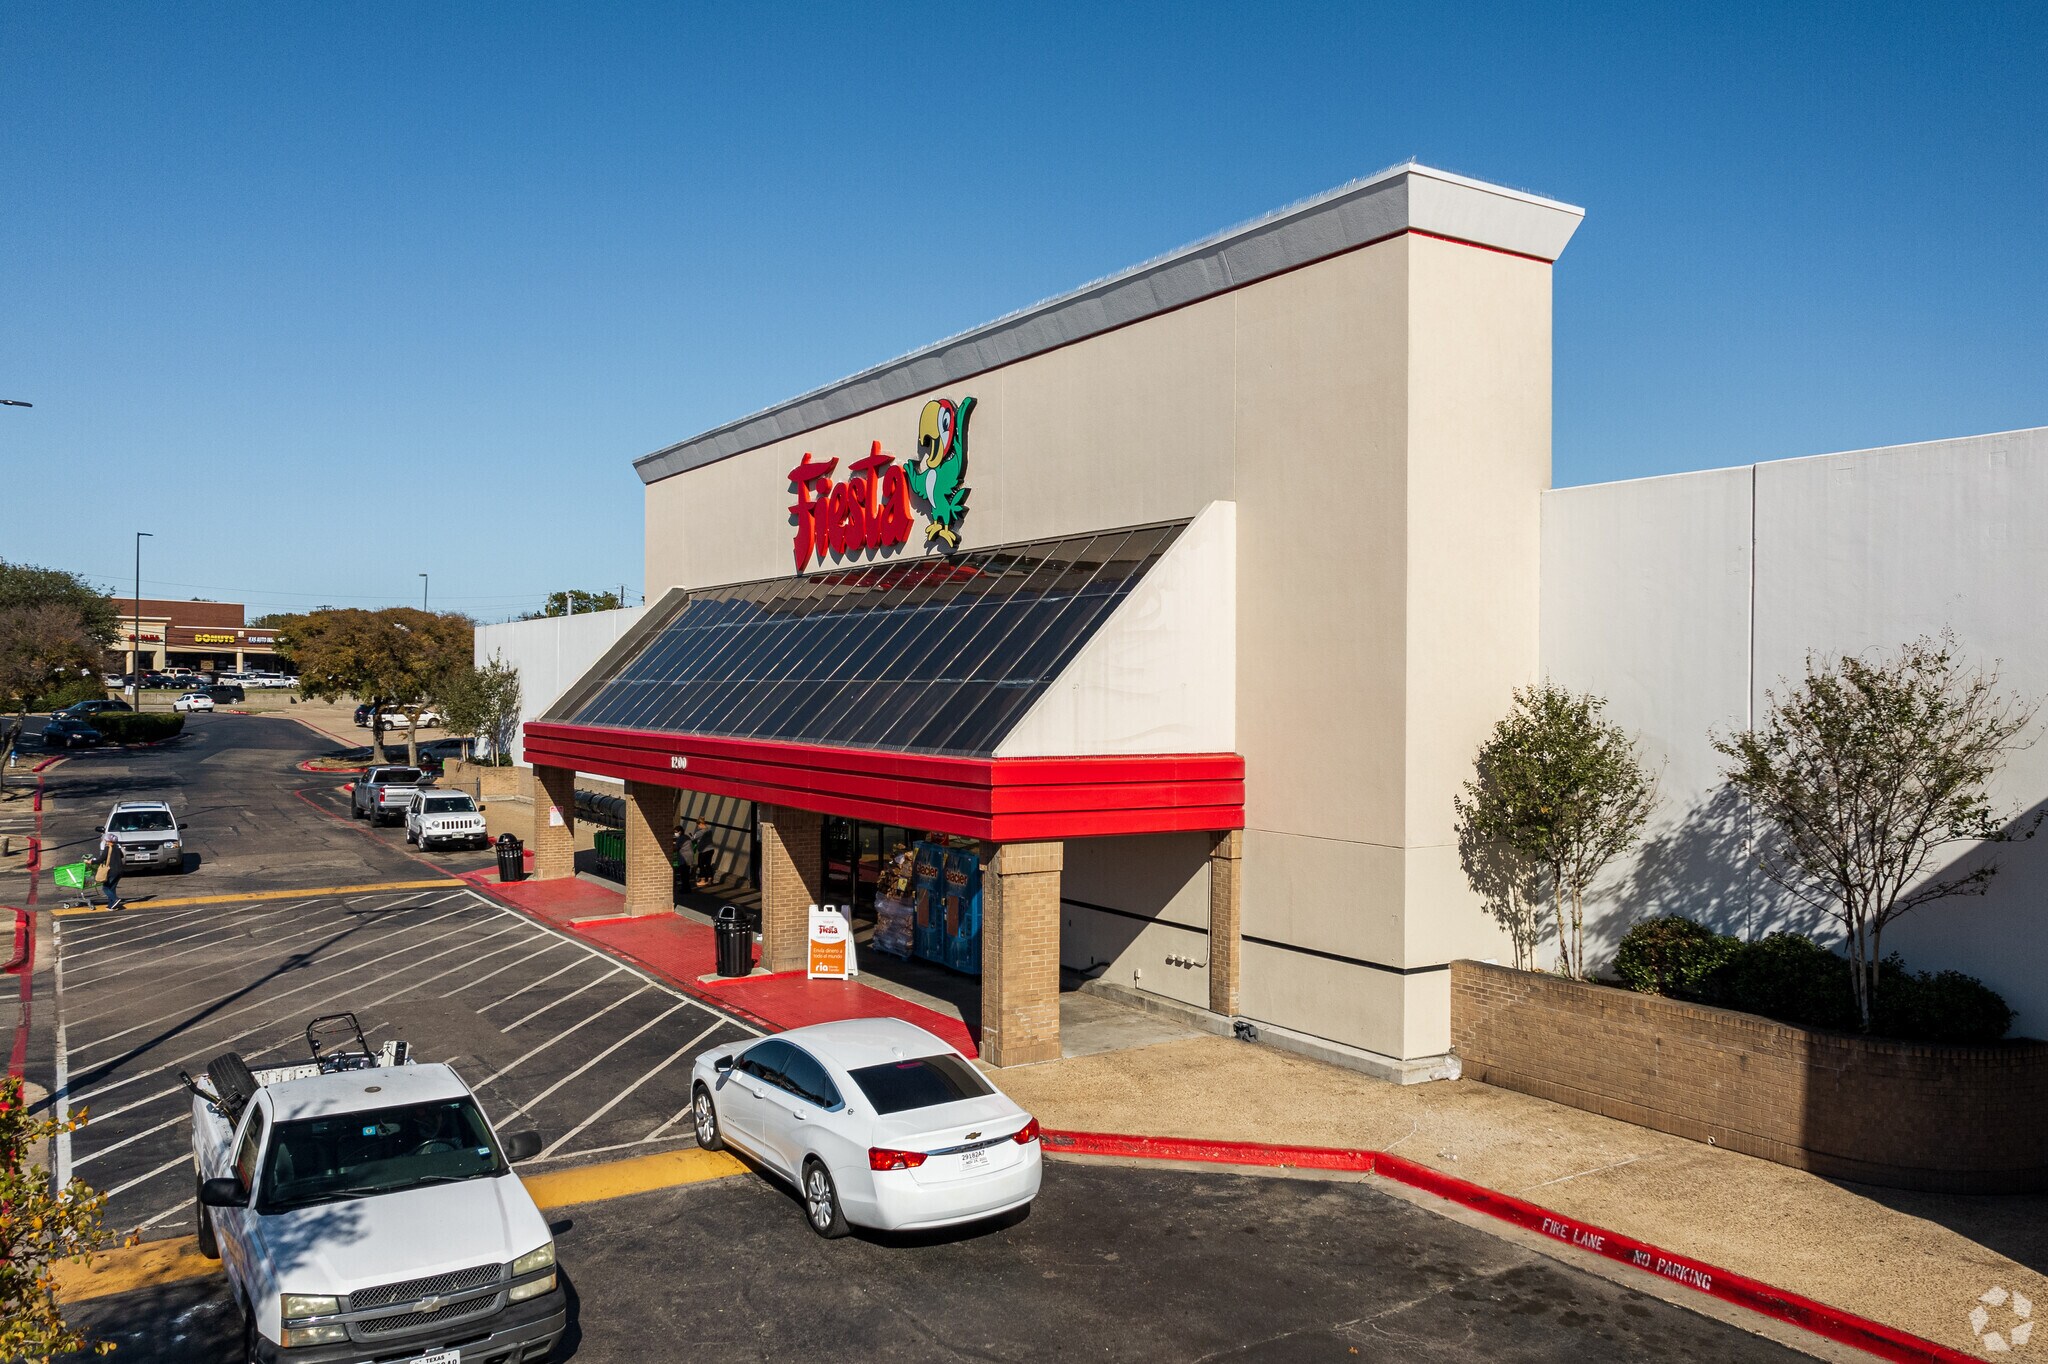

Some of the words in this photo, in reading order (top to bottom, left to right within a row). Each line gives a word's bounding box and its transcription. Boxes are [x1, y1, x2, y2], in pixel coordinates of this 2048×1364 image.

[788, 440, 914, 573] Fiesta
[194, 633, 235, 643] DONUTS
[671, 756, 687, 769] 1200
[916, 861, 938, 878] Glacier
[946, 868, 968, 885] Glacier
[816, 962, 828, 971] ria
[1542, 1218, 1569, 1239] FIRE
[1573, 1228, 1605, 1251] LANE
[1632, 1250, 1651, 1267] NO
[1656, 1257, 1712, 1291] PARKING
[426, 1354, 445, 1363] TEXAS
